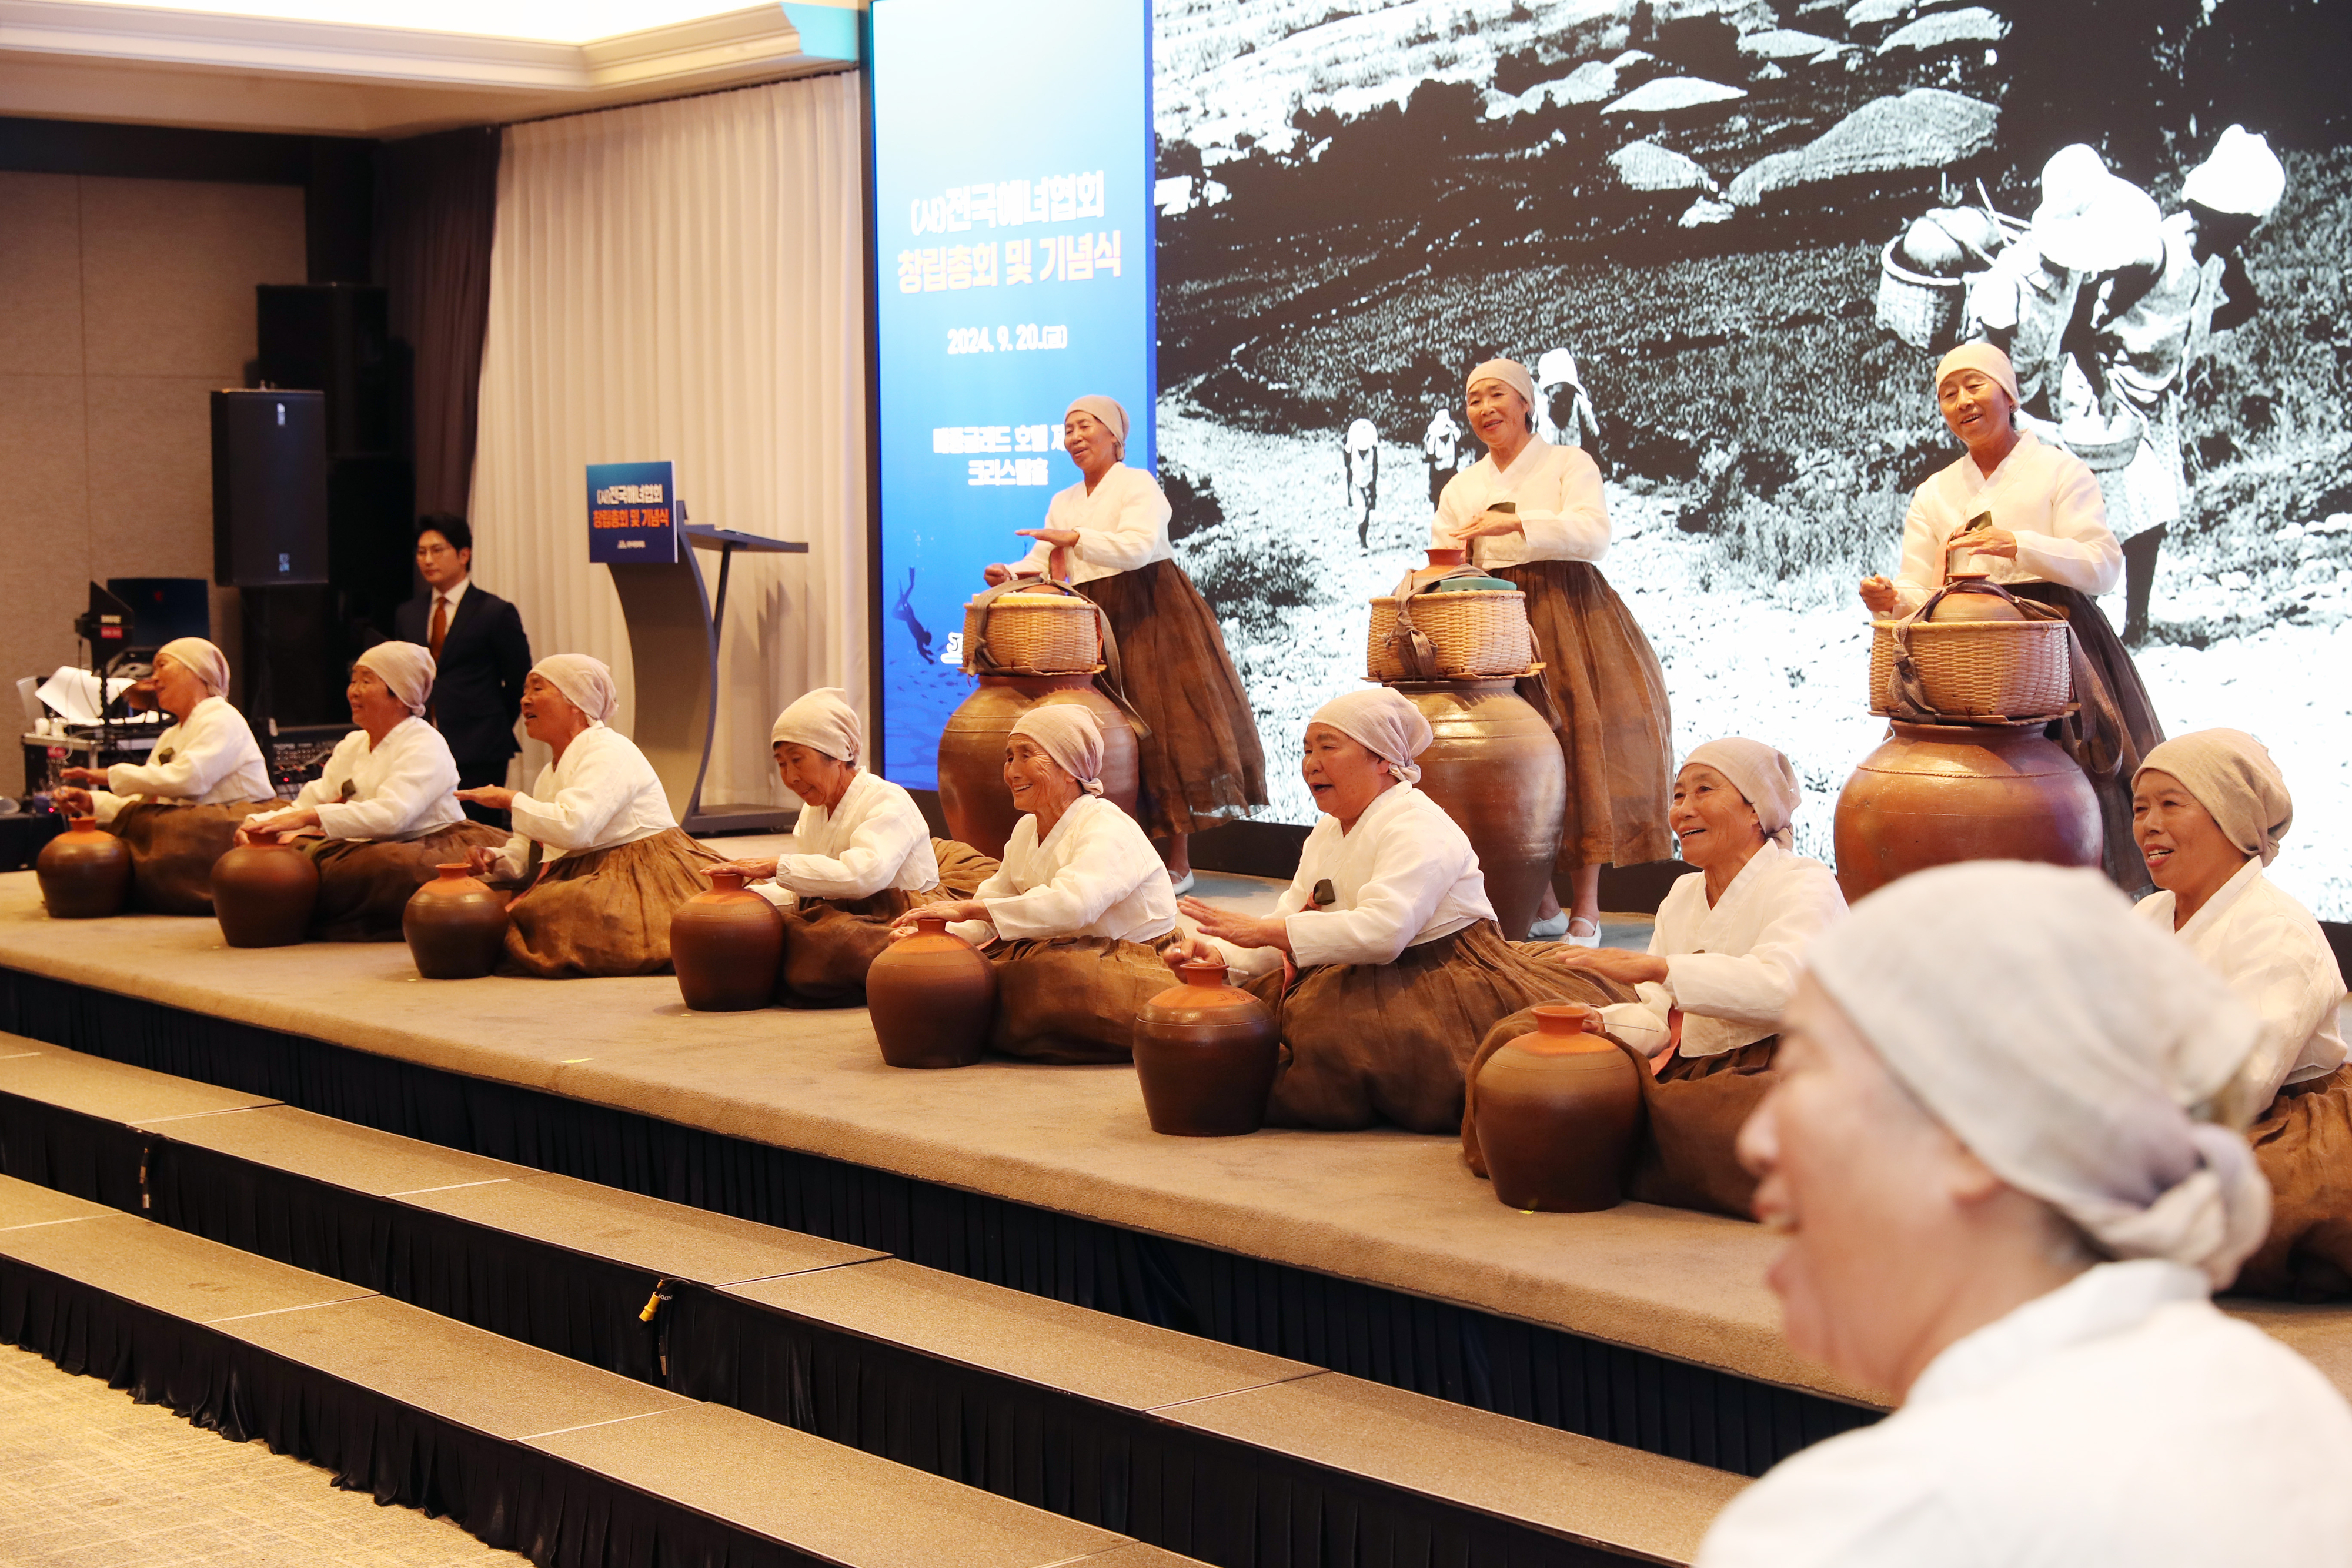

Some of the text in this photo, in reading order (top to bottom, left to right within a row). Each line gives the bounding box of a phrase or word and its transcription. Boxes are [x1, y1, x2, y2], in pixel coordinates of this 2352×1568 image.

[897, 230, 1122, 294] 창립총회 및 기념식
[947, 326, 994, 355] 2024.
[996, 325, 1013, 352] 9.
[593, 507, 670, 529] 창립총회 및 기념식
